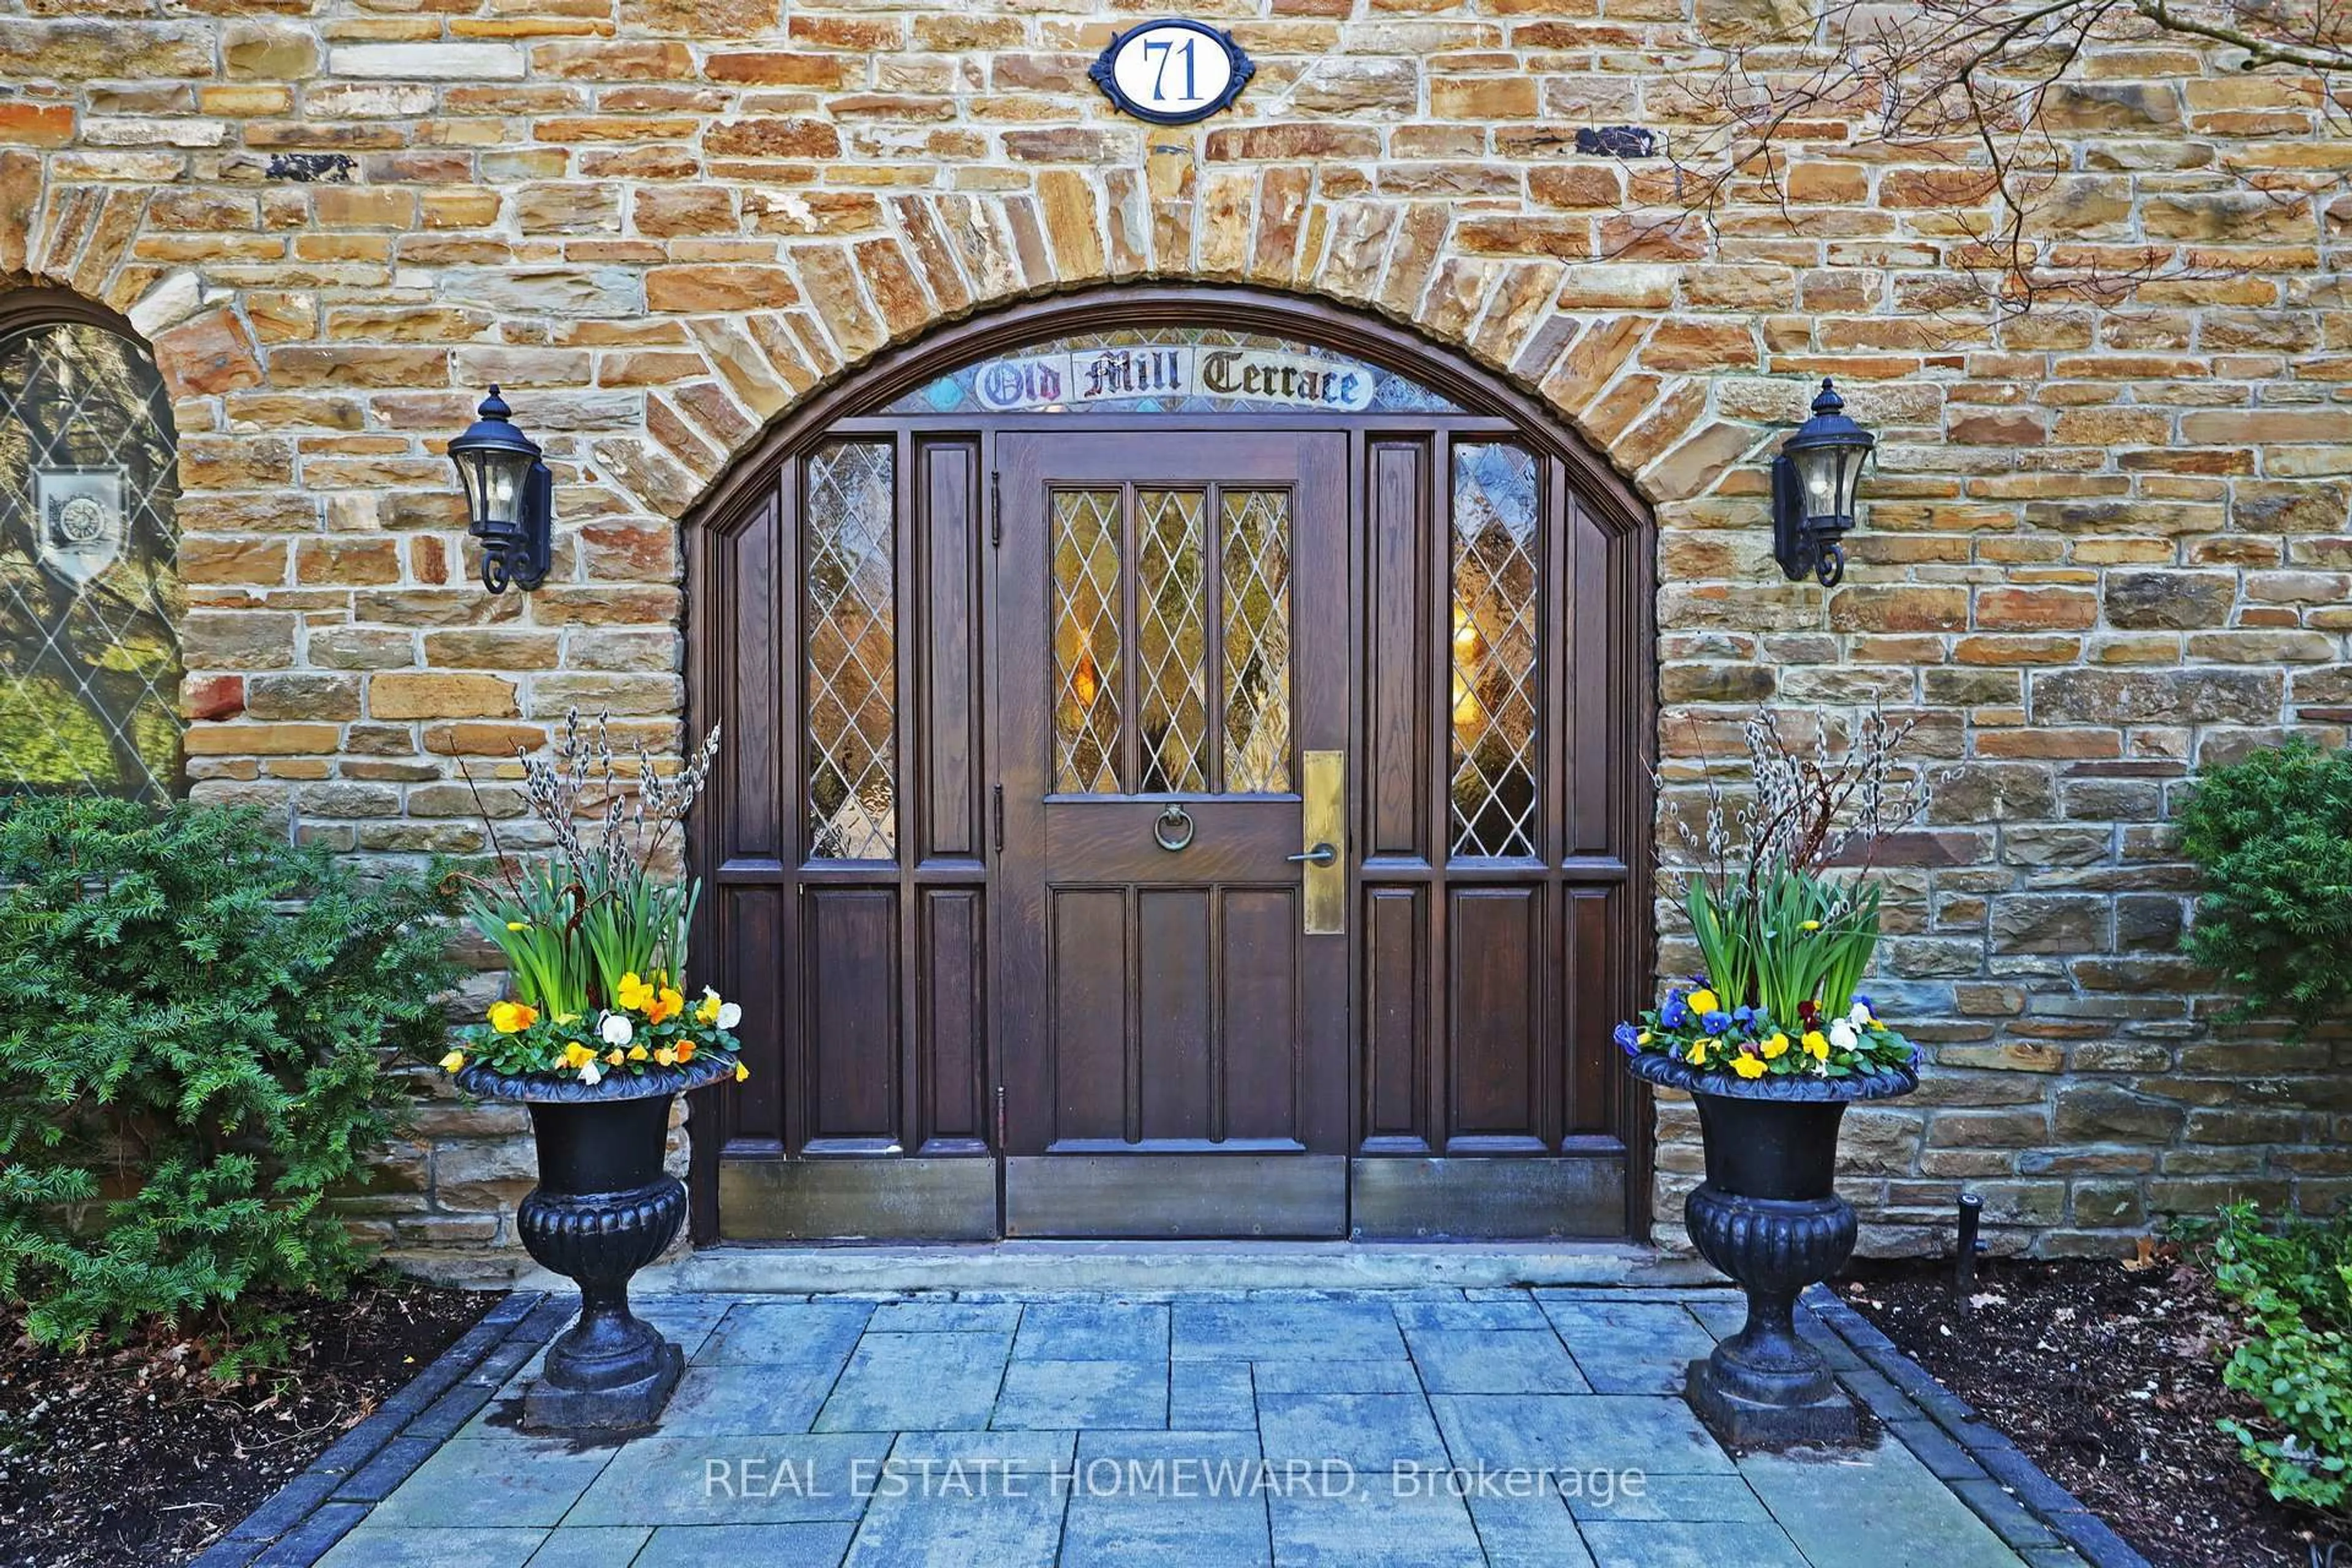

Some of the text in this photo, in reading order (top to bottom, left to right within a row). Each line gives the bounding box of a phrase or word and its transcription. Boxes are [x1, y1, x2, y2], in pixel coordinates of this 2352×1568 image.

[1144, 38, 1204, 100] 71
[984, 350, 1359, 405] Old Mill Terrace
